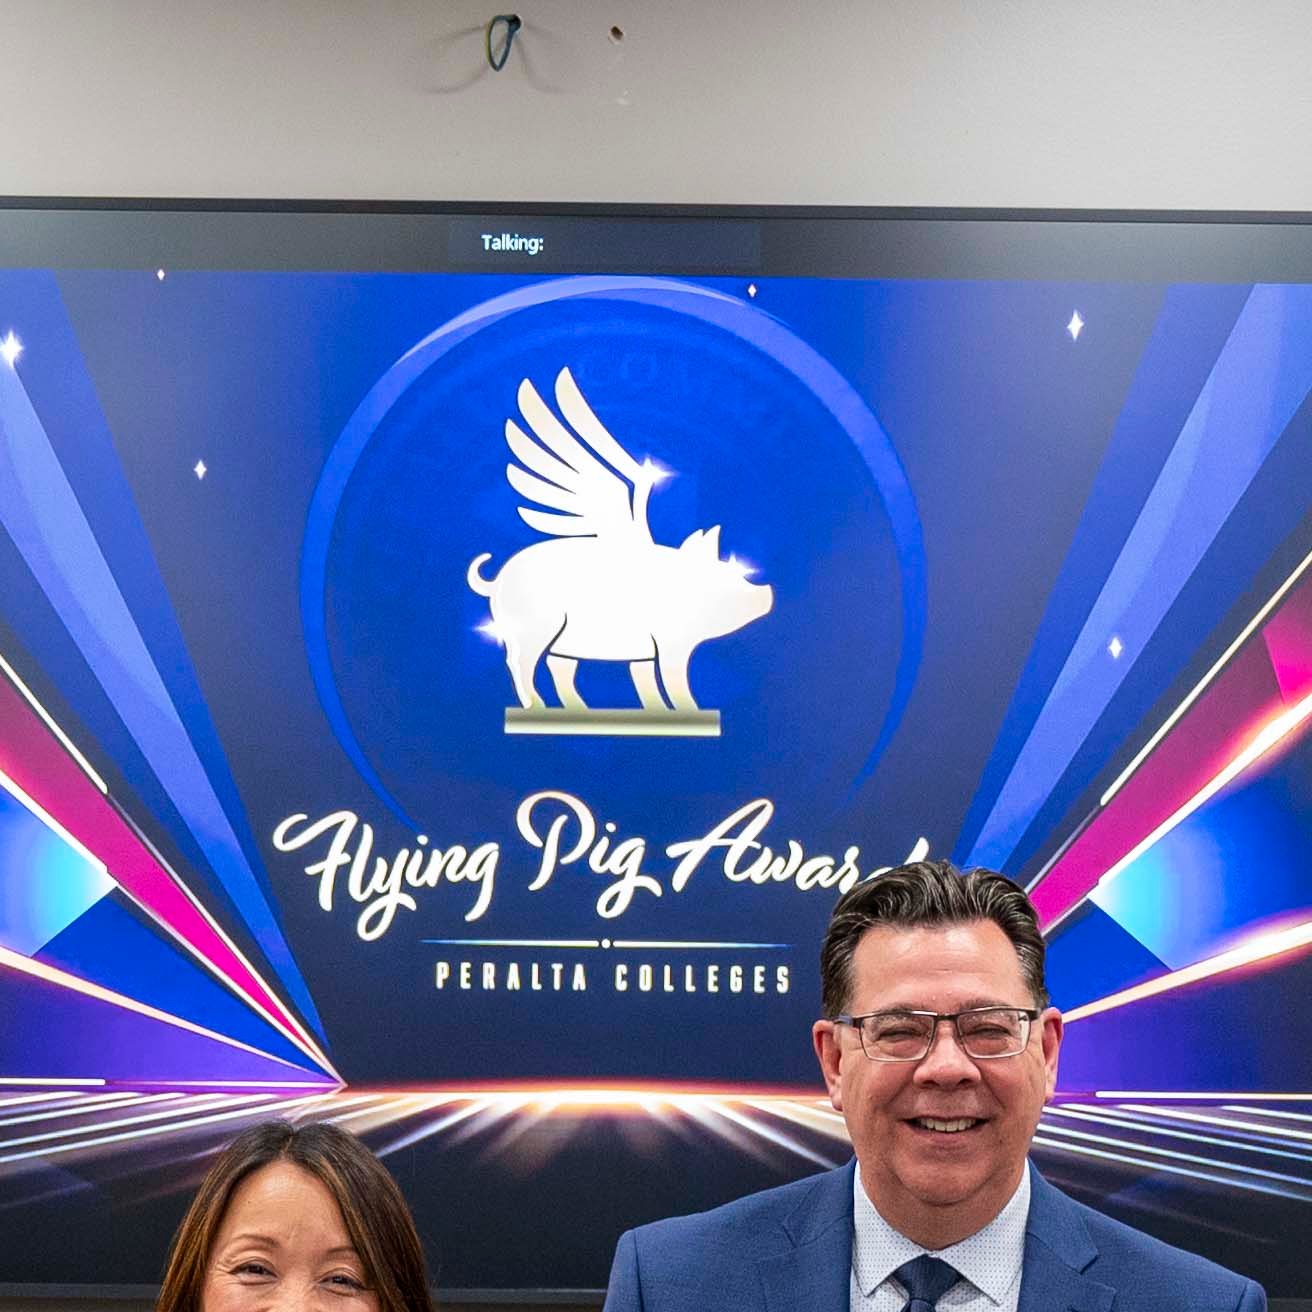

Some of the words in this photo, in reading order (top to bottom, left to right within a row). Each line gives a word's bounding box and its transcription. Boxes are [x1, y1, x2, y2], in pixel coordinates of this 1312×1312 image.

[481, 234, 544, 255] Talking:
[272, 810, 499, 942] Flying
[516, 791, 662, 919] Pig
[436, 961, 587, 991] PERALTA
[615, 964, 790, 994] COLLEGES
